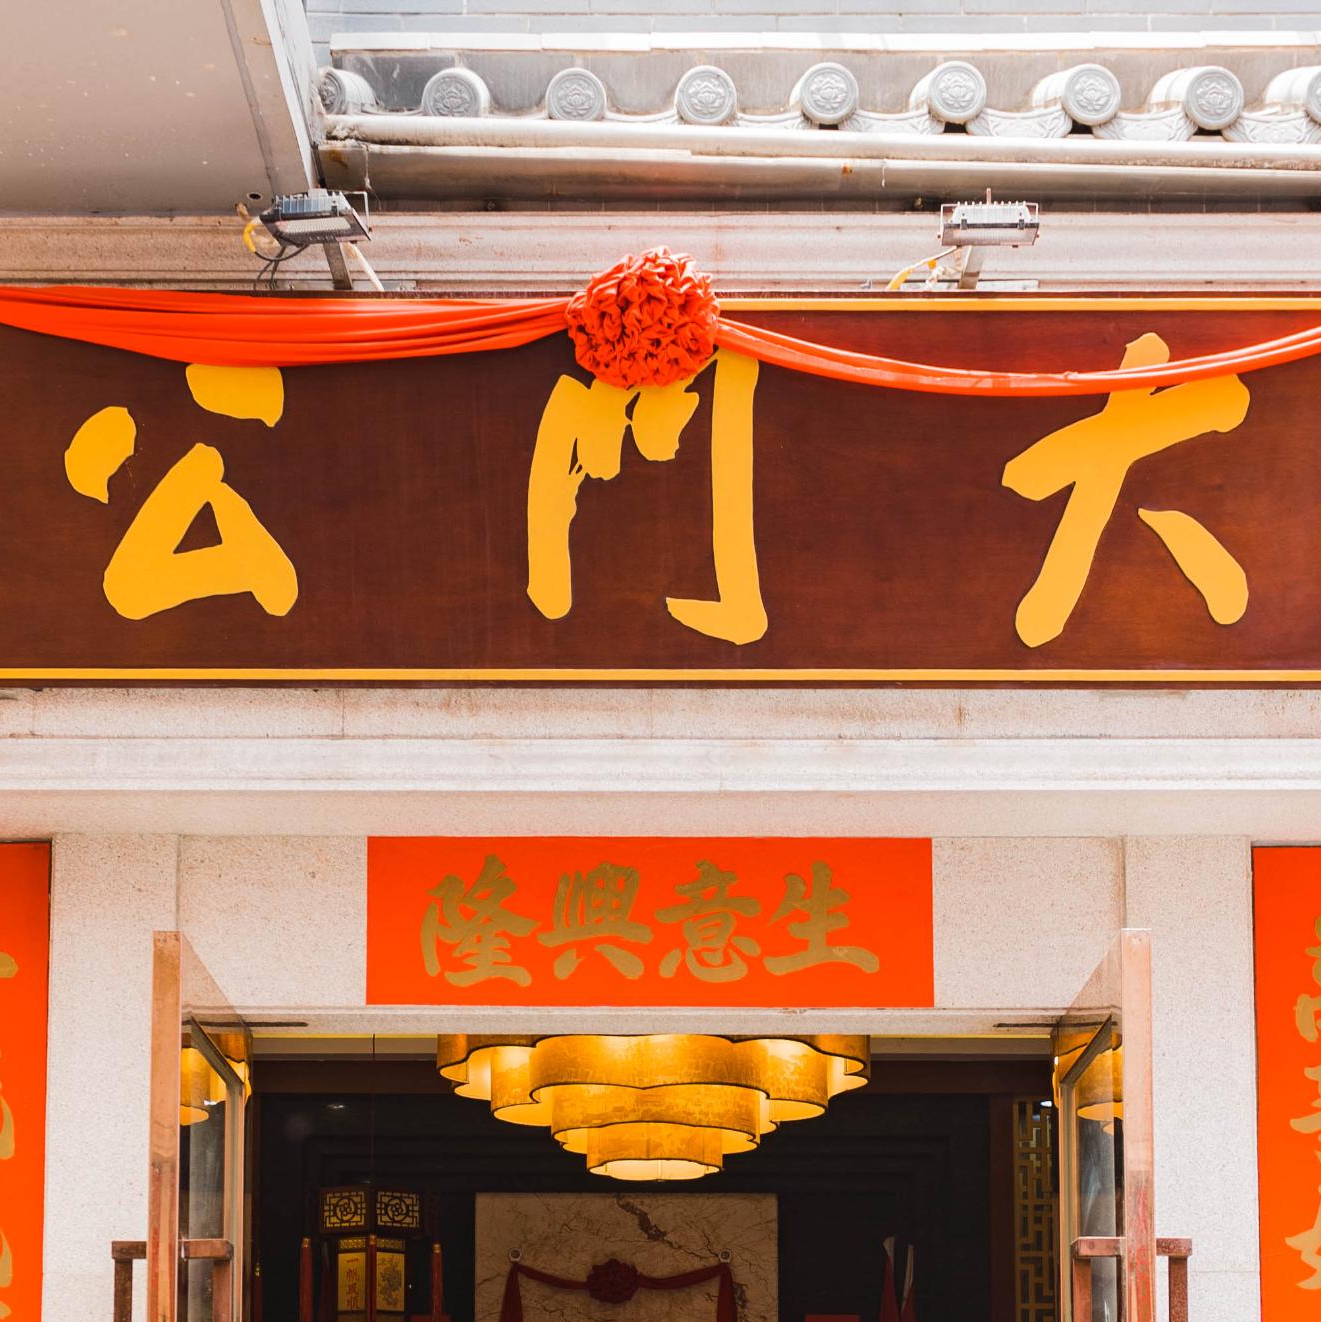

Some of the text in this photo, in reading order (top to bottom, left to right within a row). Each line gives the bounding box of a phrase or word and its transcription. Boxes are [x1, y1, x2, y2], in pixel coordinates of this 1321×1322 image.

[65, 332, 1250, 648] 大門公
[420, 853, 880, 988] 生意興隆
